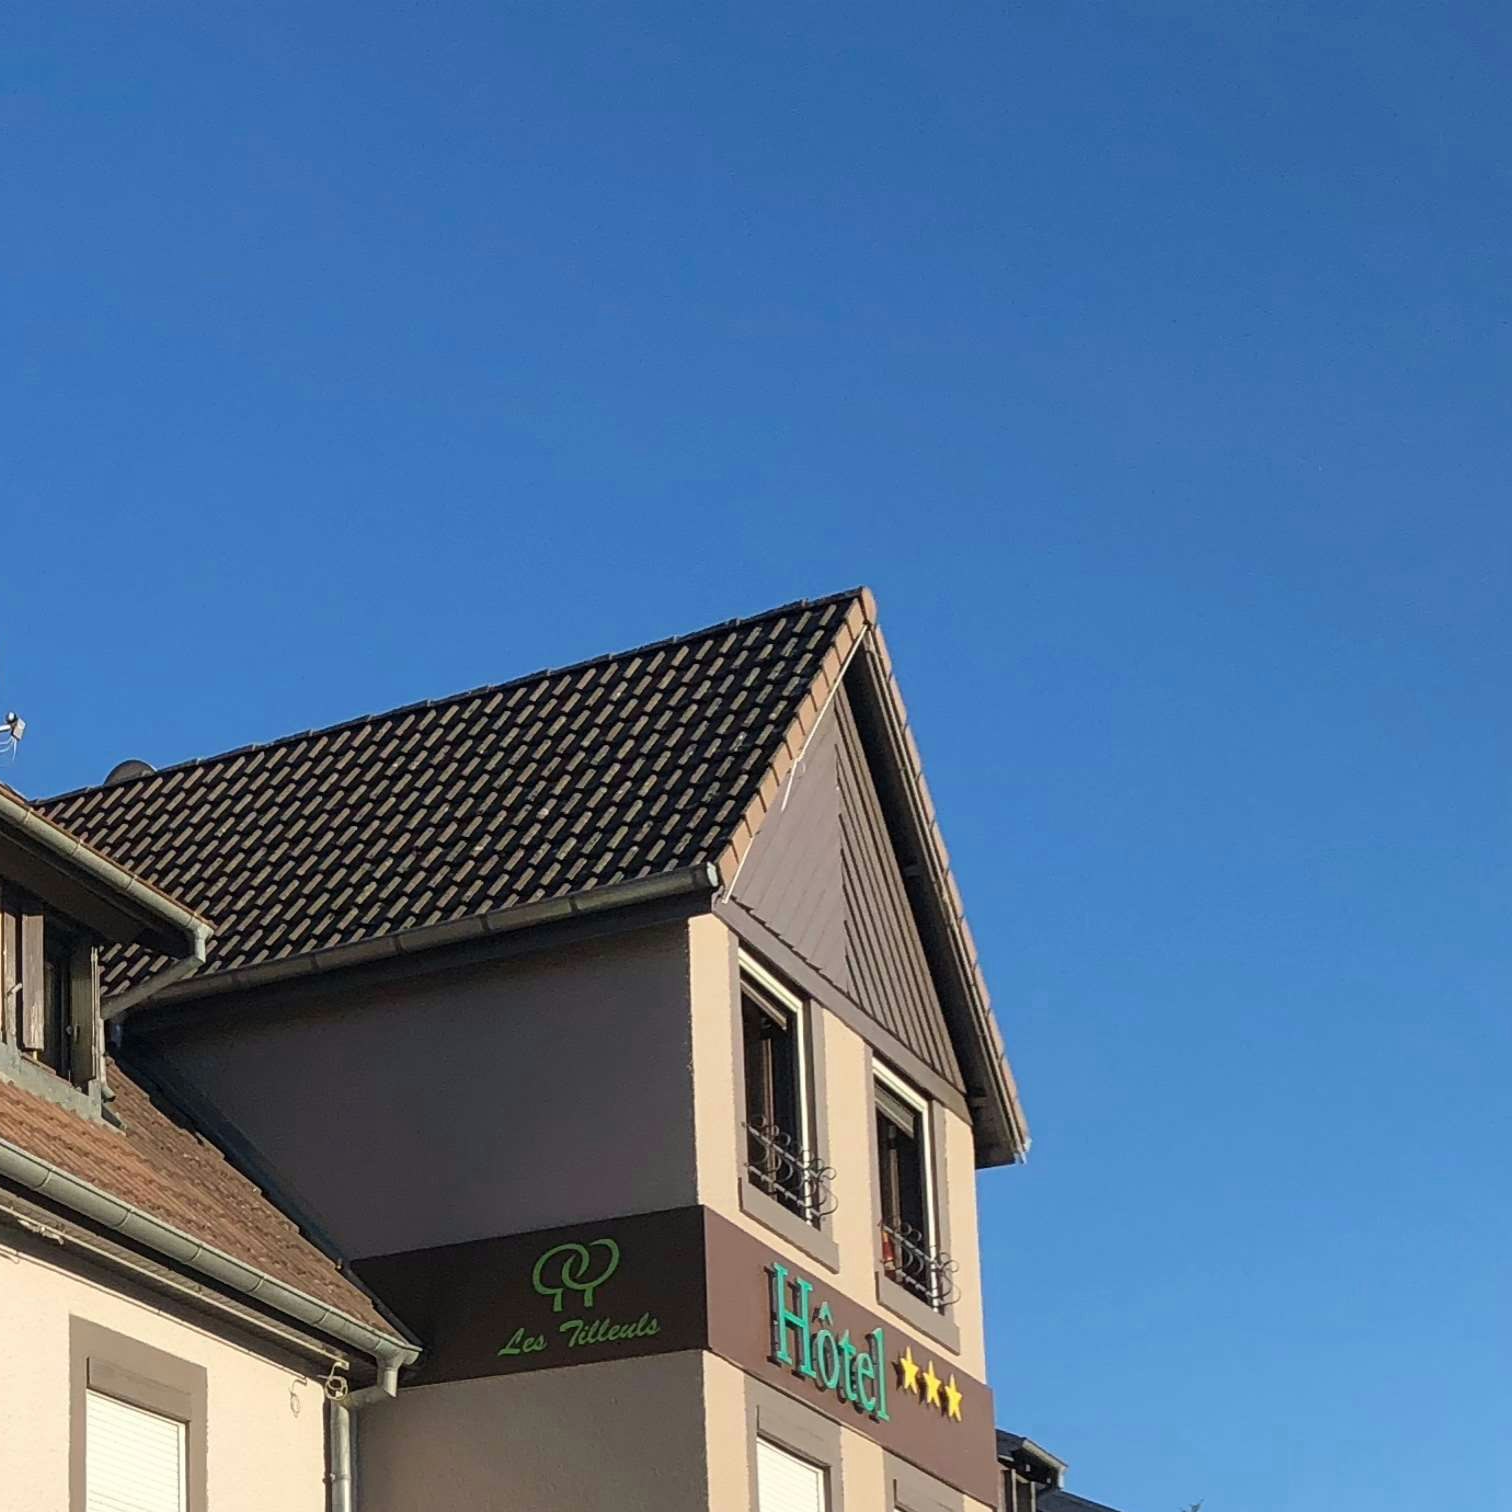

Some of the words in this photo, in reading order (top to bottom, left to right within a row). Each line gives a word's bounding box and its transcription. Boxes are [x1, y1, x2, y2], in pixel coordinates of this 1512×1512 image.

[497, 1327, 548, 1356] Les
[559, 1311, 661, 1348] Tilleuls
[773, 1262, 890, 1422] Hôtel
